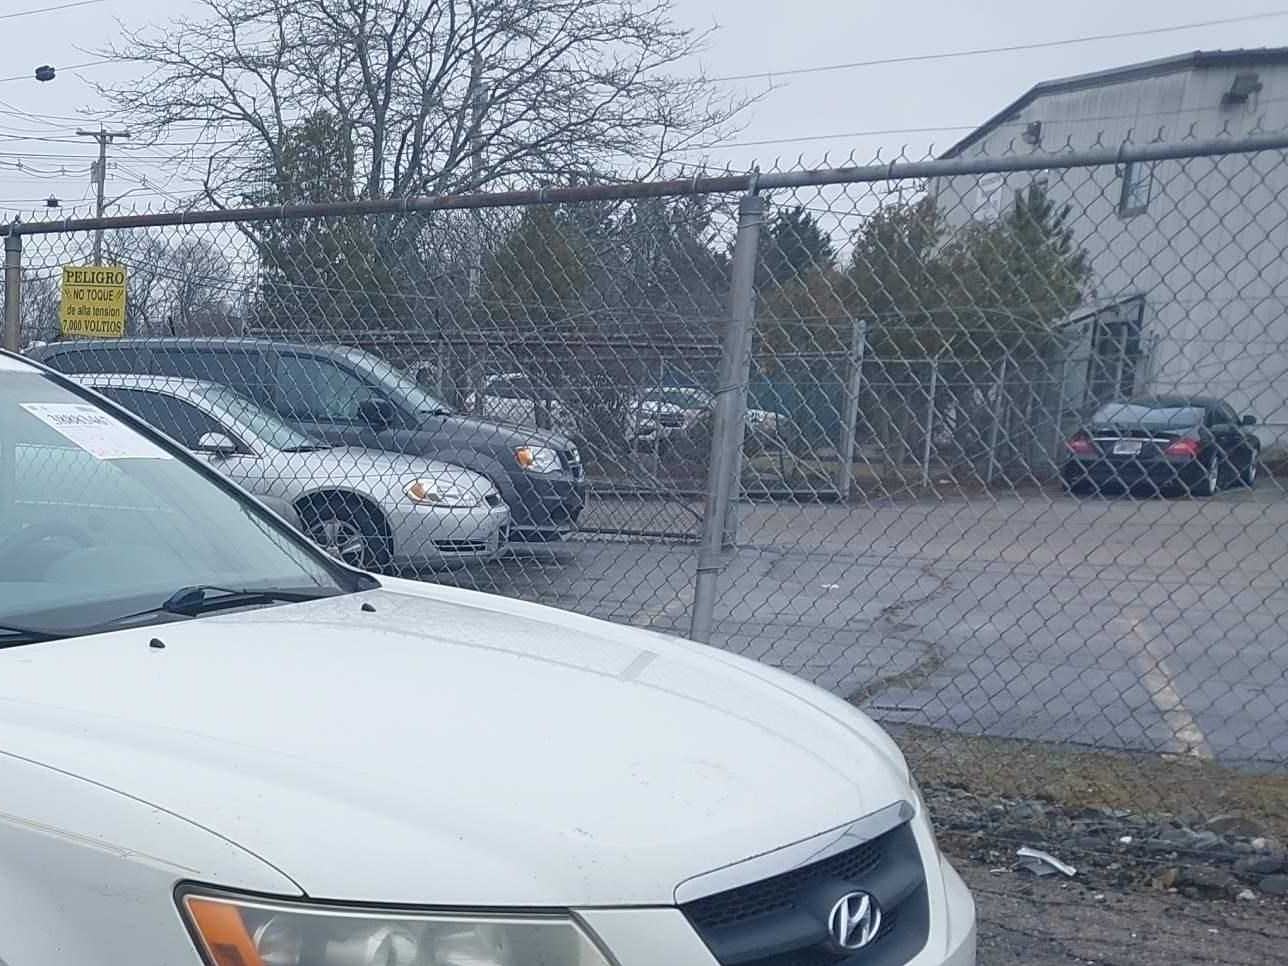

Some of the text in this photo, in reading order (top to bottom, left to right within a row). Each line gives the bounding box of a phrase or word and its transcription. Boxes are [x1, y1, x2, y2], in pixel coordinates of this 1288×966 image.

[66, 271, 125, 284] PELIGRO
[73, 288, 113, 301] NO TOQUE
[84, 320, 121, 333] VOLTIOS
